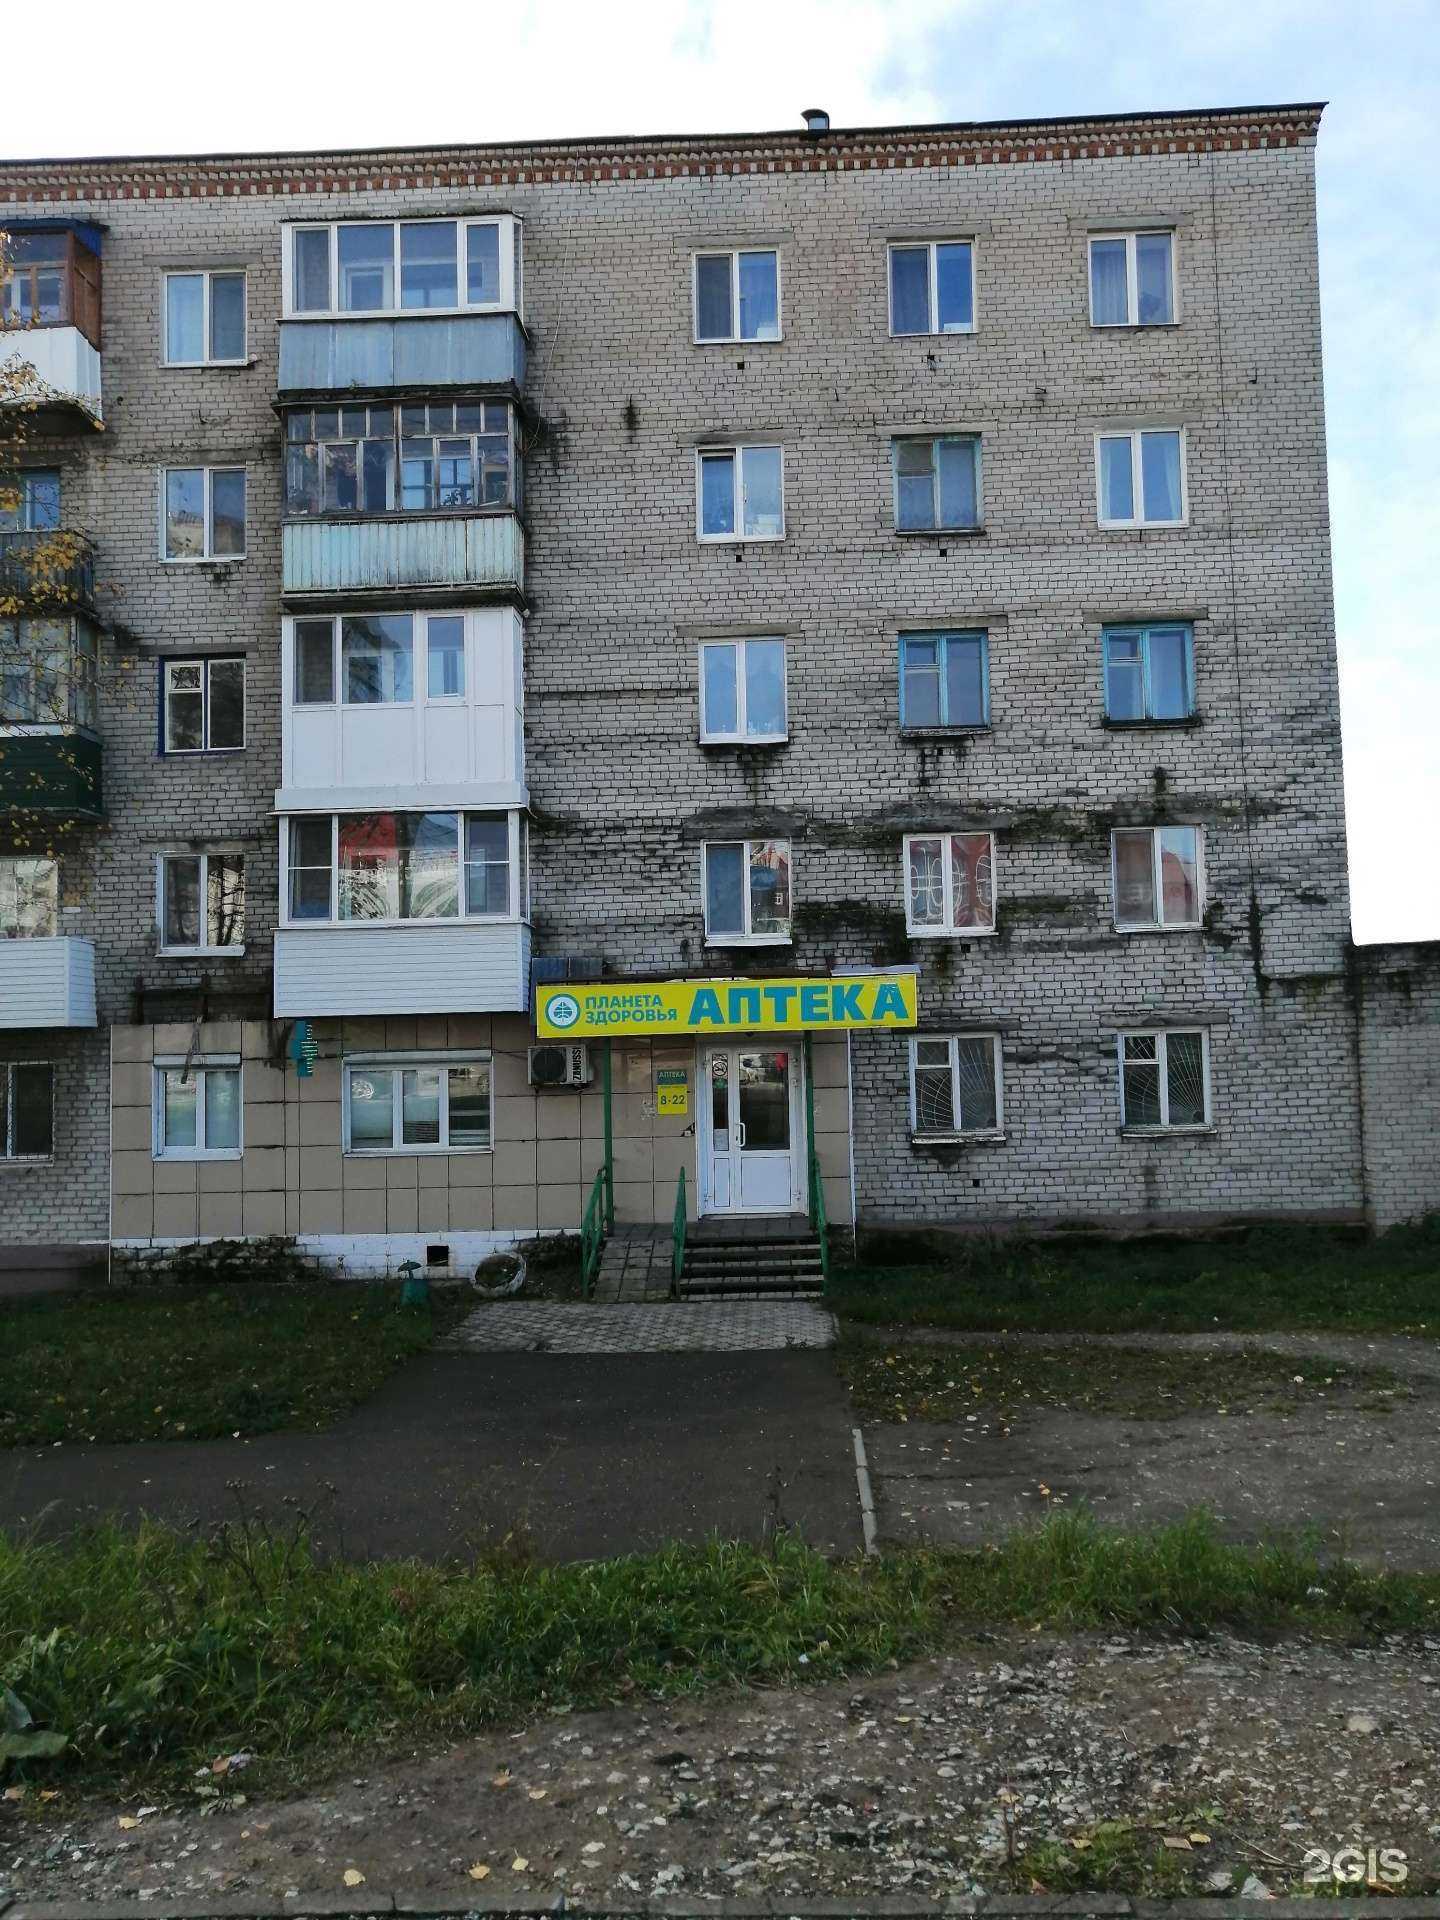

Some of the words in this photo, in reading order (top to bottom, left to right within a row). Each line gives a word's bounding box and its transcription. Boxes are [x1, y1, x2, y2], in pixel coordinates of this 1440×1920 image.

[585, 994, 663, 1010] ПЛАНЕТА
[687, 983, 909, 1025] АПТЕКА
[585, 1008, 677, 1025] ЗДОРОВЬЯ
[572, 1048, 582, 1081] ZANUSSI
